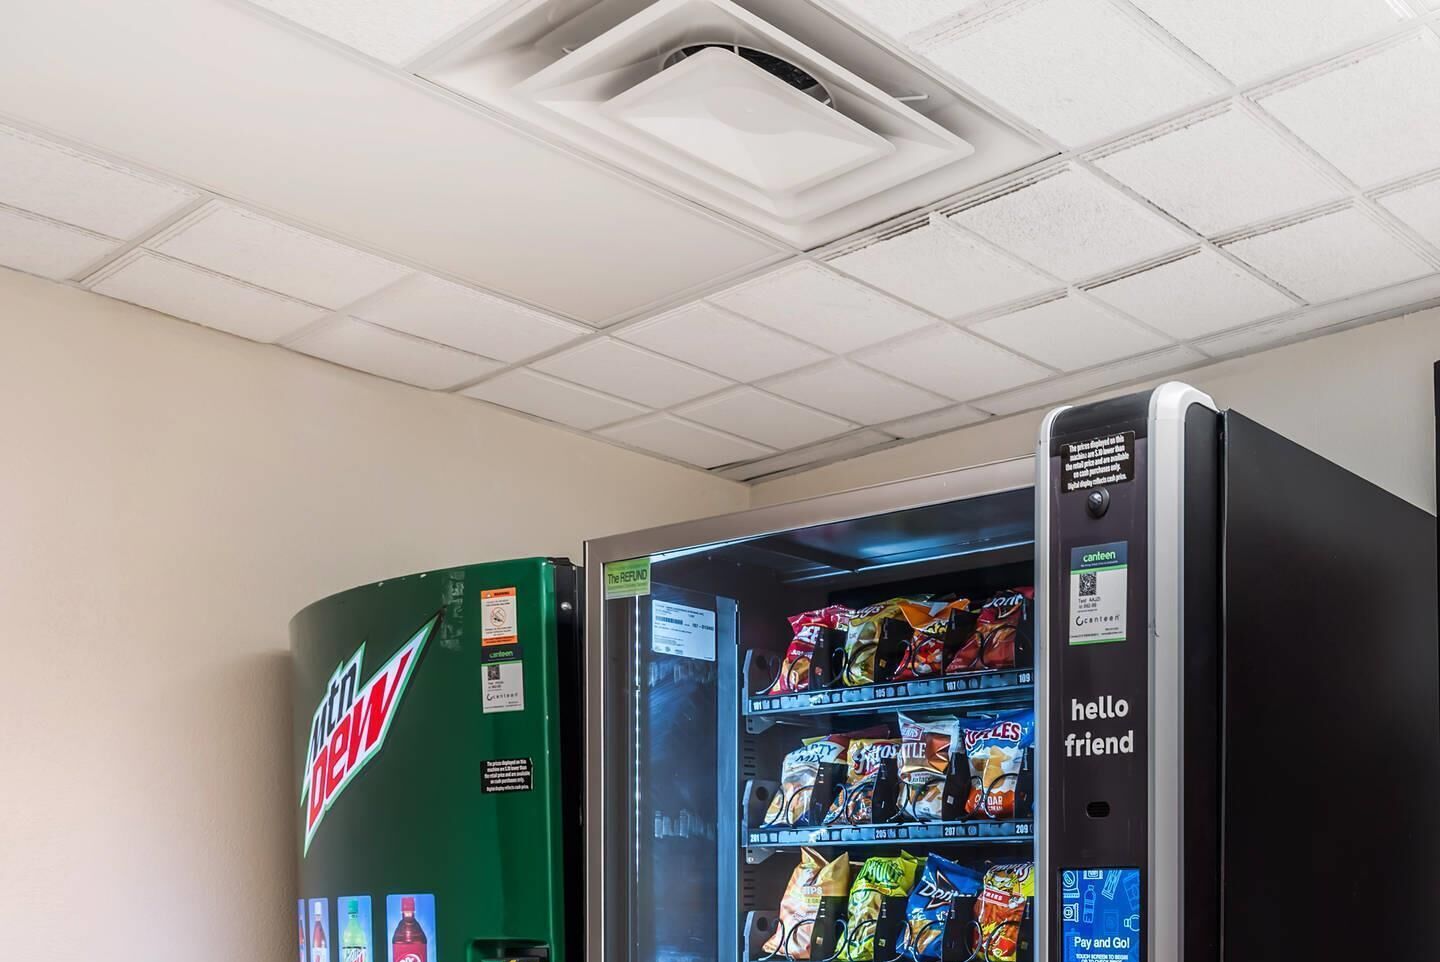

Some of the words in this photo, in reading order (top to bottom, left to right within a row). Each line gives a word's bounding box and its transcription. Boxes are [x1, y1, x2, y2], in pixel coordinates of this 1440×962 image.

[1083, 551, 1116, 562] canteen
[608, 574, 619, 585] The
[620, 569, 647, 584] REFUND
[876, 688, 885, 698] 105
[1018, 673, 1030, 683] 109
[1072, 695, 1129, 721] hello
[1065, 730, 1134, 757] friend
[876, 829, 887, 838] 205
[945, 826, 956, 836] 207
[1016, 824, 1028, 834] 209
[1074, 936, 1092, 950] Pay
[1094, 937, 1110, 948] and
[1112, 937, 1130, 948] Go!
